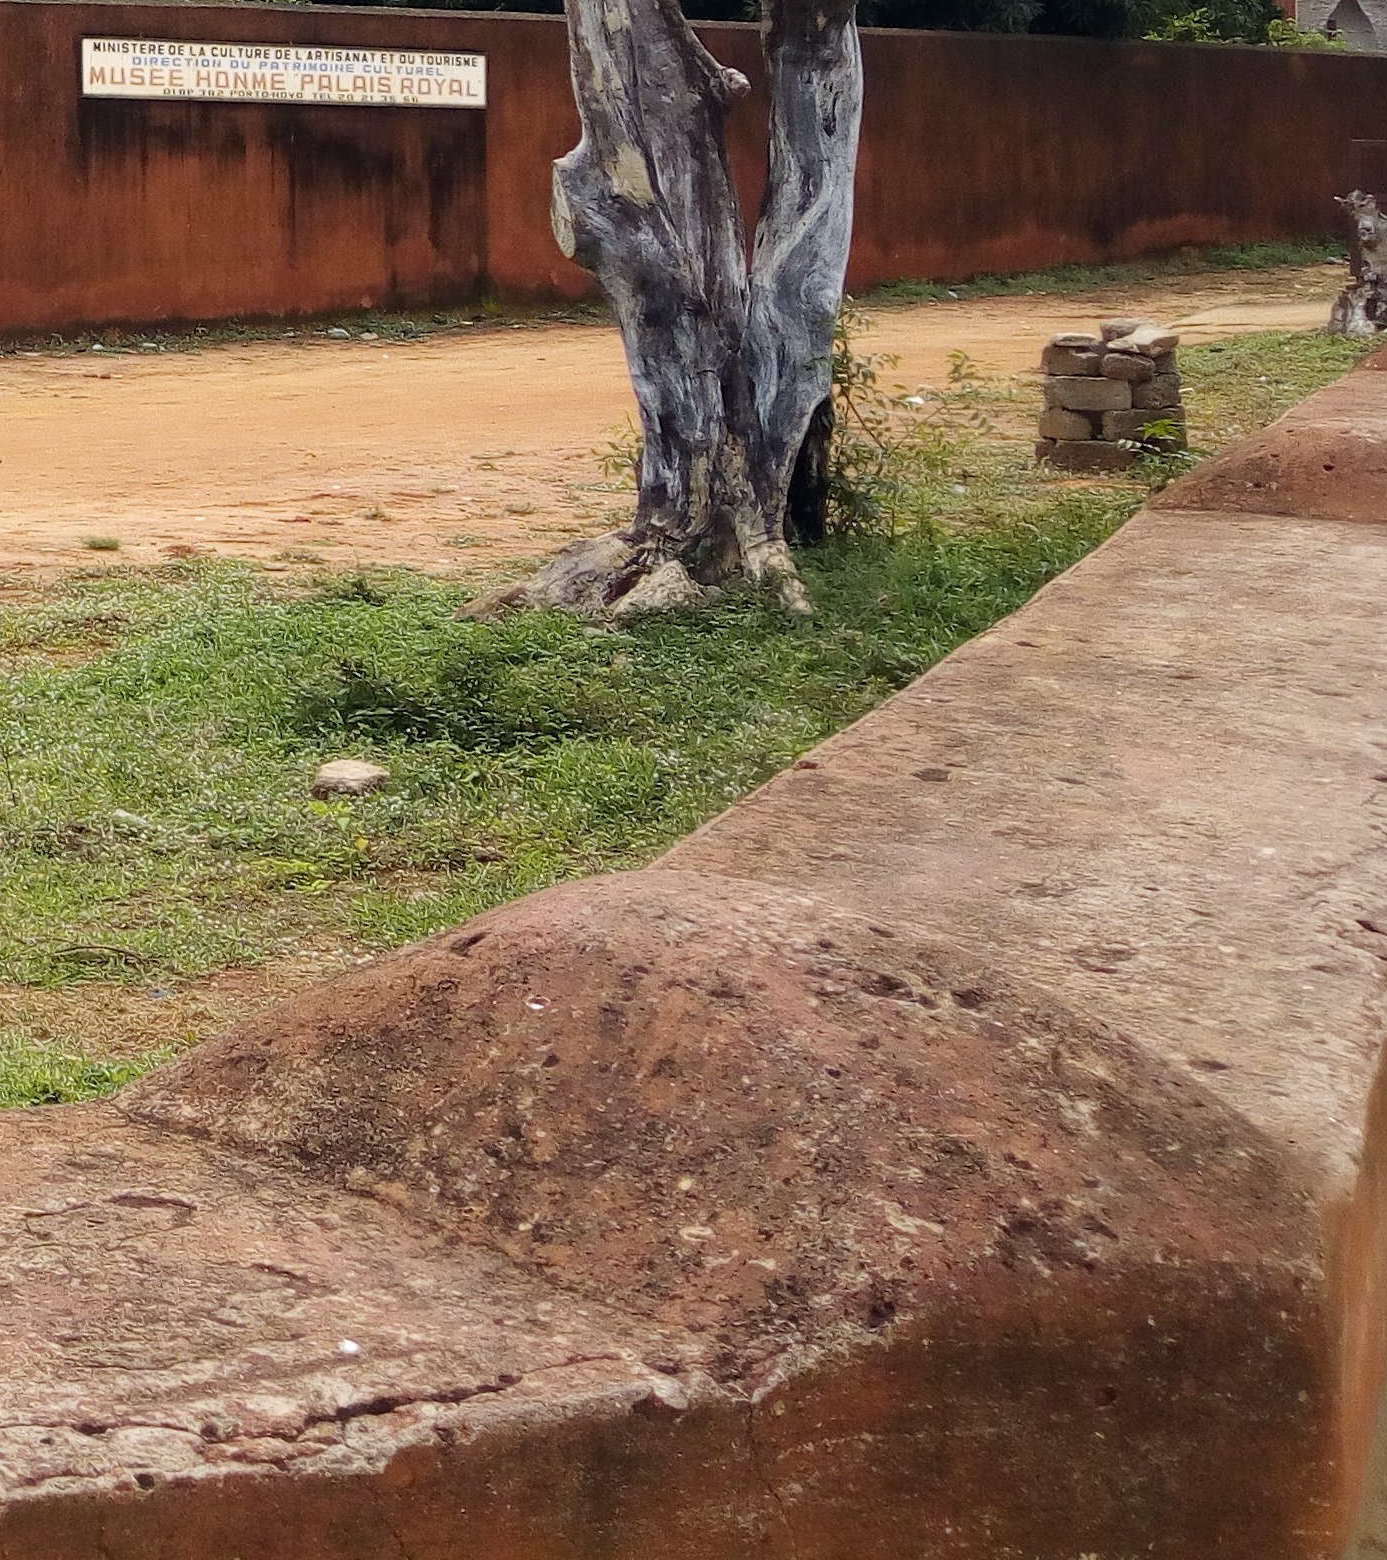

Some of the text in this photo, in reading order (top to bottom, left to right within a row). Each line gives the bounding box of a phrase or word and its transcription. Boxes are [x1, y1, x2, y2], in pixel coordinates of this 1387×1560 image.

[93, 42, 478, 67] MINISTERE DE LA CULTURE DE L'ARTISANAT ET DU TOURISME
[132, 56, 444, 76] DIRECTION DU PATRIMOINE CULTUREL
[89, 67, 184, 87] MUSEE
[196, 71, 285, 90] HONME
